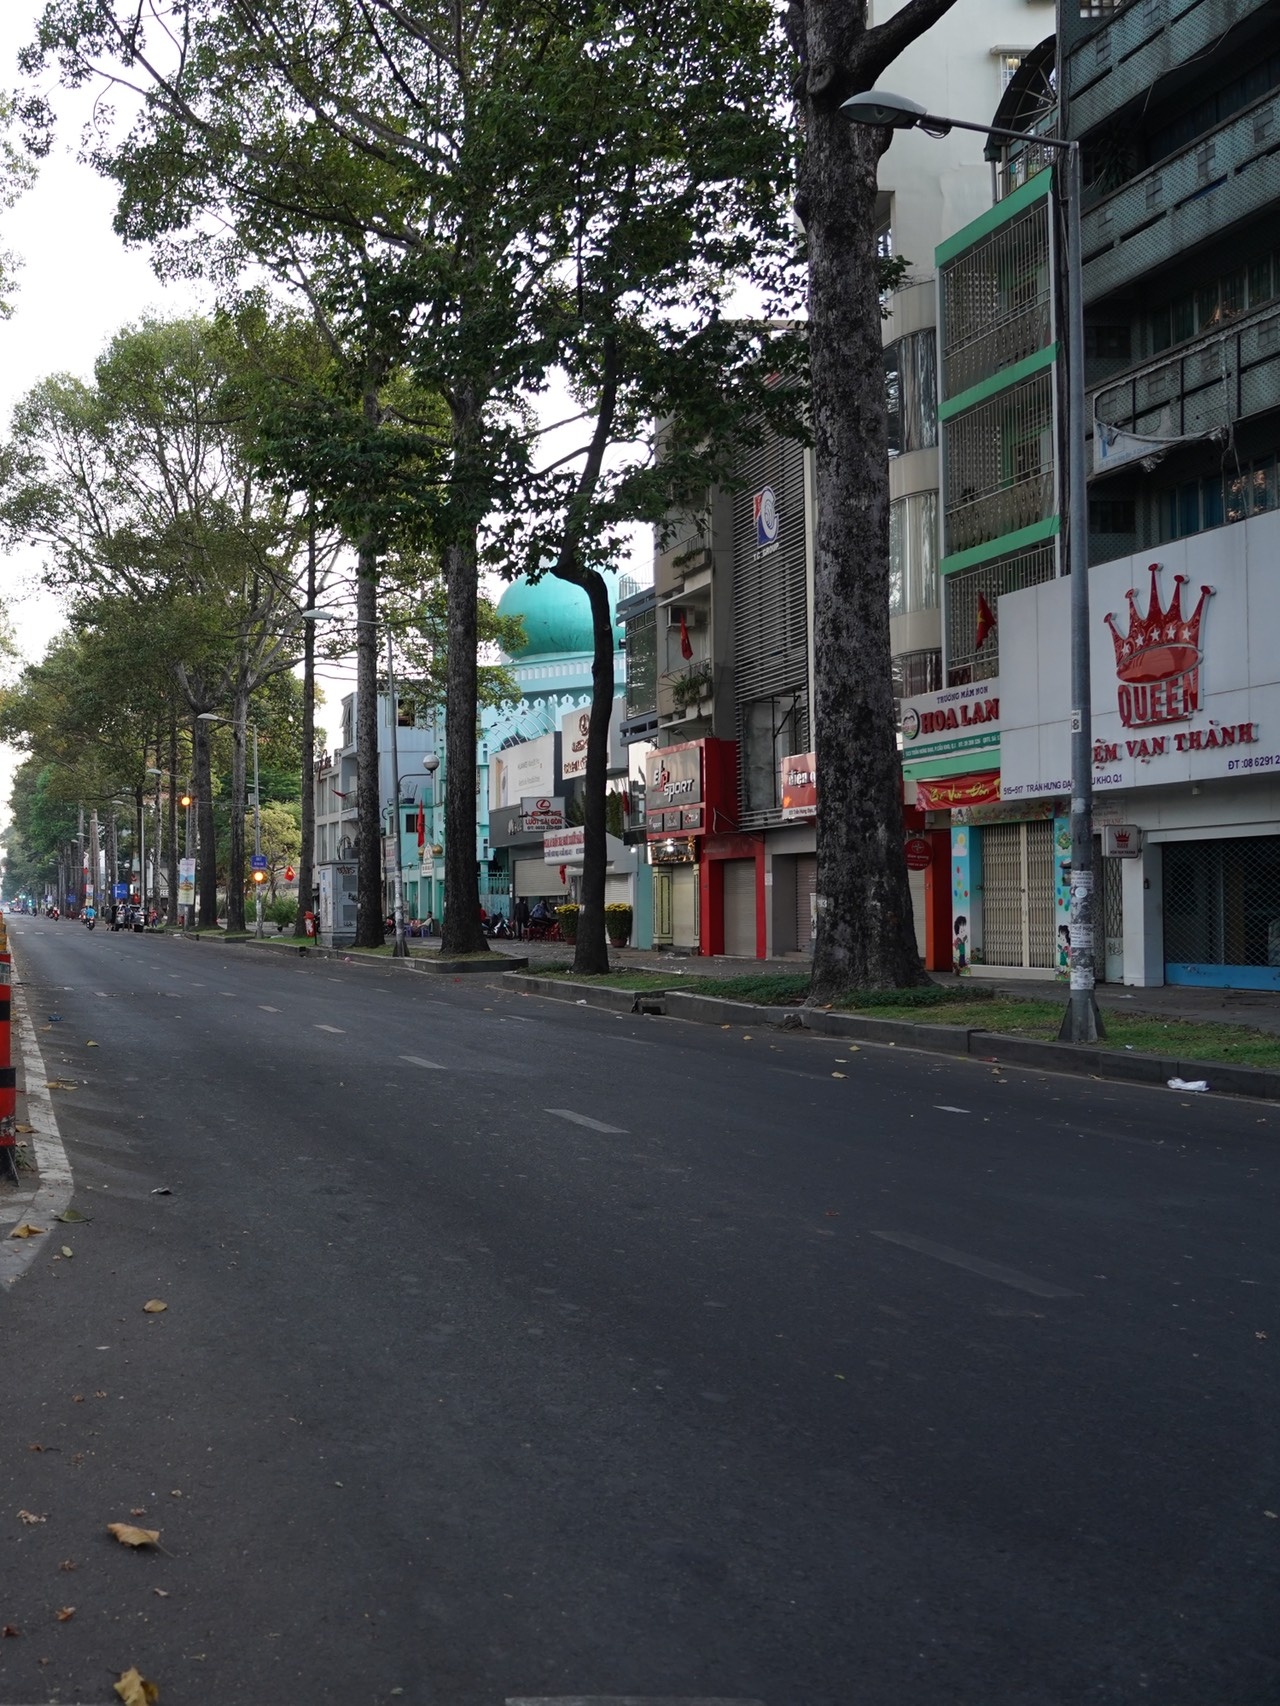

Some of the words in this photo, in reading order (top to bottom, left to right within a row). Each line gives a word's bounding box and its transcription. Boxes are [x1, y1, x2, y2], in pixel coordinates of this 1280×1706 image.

[920, 707, 959, 735] HOA
[960, 698, 1000, 727] LAN
[1117, 667, 1199, 728] QUEEN
[1125, 735, 1169, 765] VẠN
[1173, 719, 1257, 753] THÀNH
[1043, 780, 1062, 791] HƯNG
[1062, 780, 1072, 791] ĐẠ
